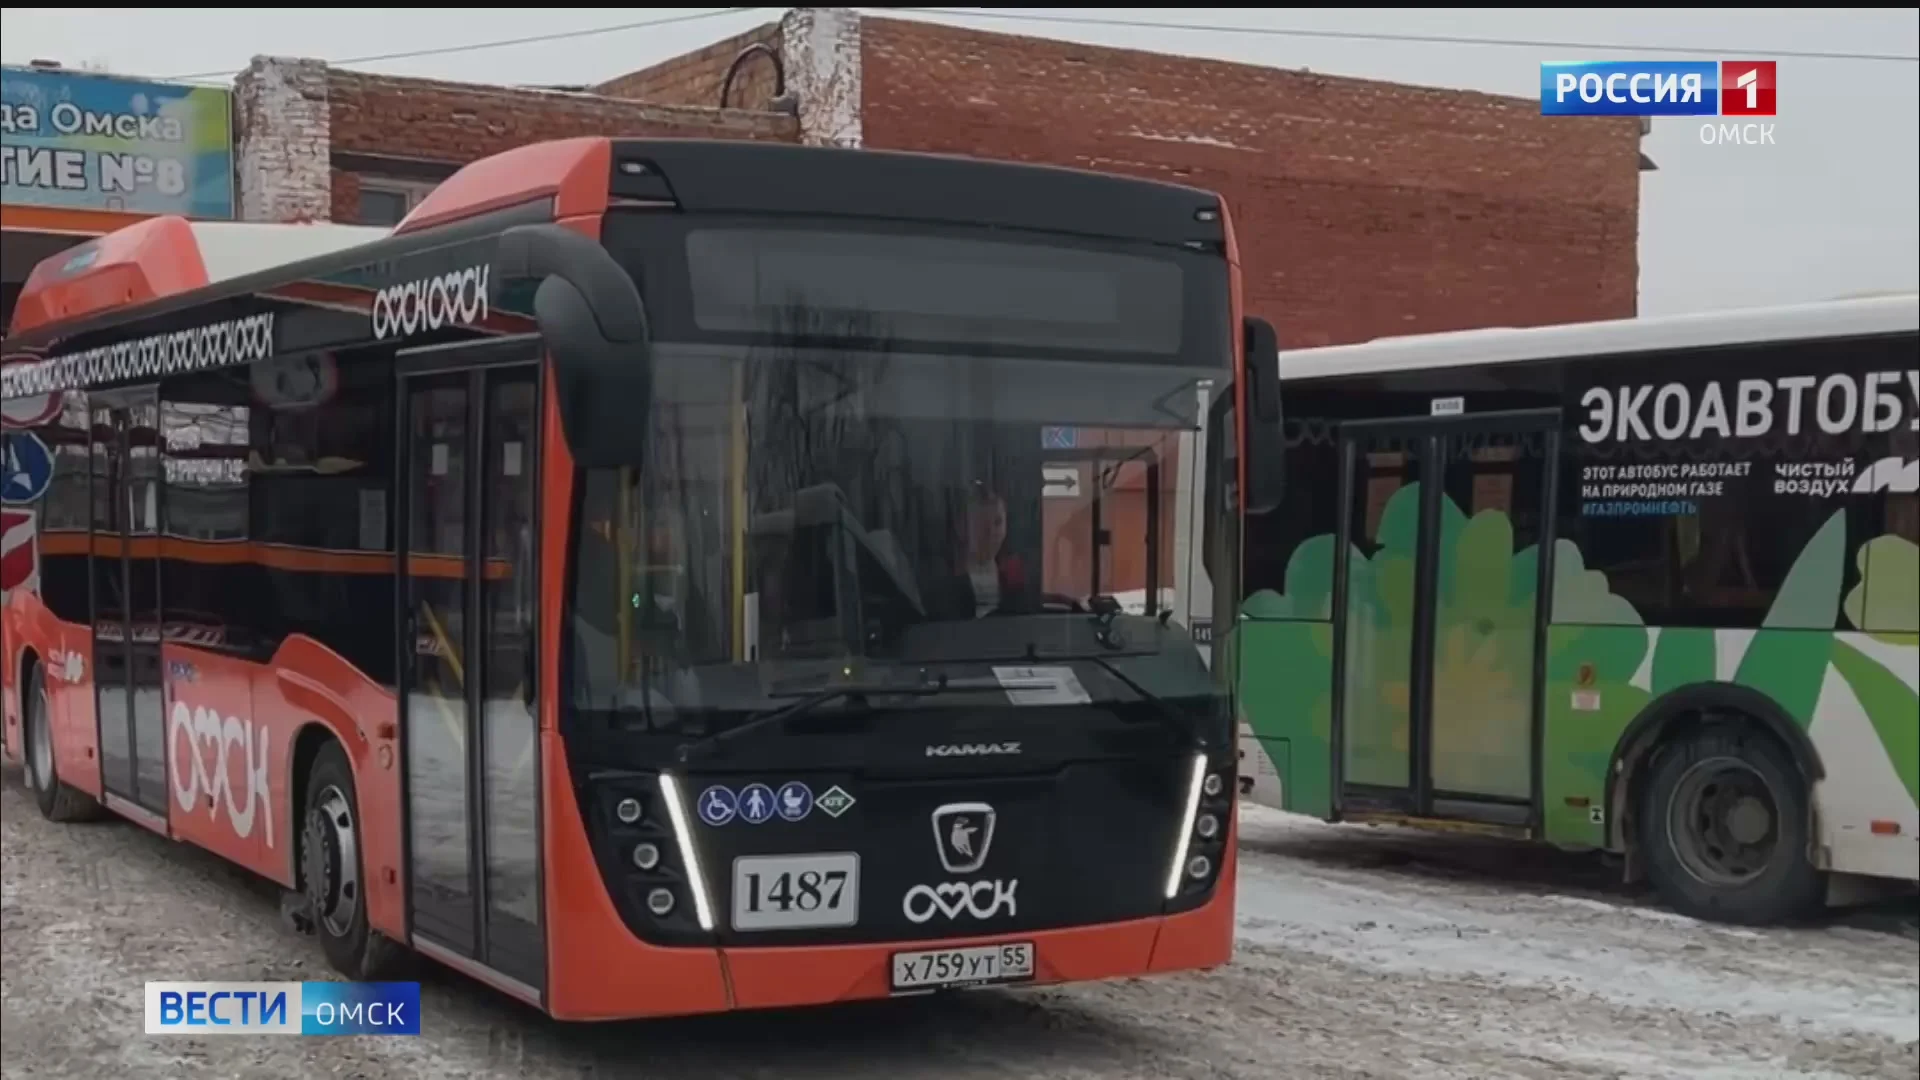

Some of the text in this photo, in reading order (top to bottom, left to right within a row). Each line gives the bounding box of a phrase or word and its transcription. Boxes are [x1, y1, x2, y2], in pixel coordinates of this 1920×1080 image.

[51, 103, 183, 140] Омска
[100, 152, 185, 195] №8
[1582, 461, 1752, 480] ЭТОТ АВТОБУС РАБОТАЕТ
[1582, 481, 1724, 500] НА ПРИРОДНОМ ГАЗЕ
[925, 741, 1022, 757] KAMAZ
[744, 870, 848, 913] 1487
[1003, 947, 1025, 966] 55
